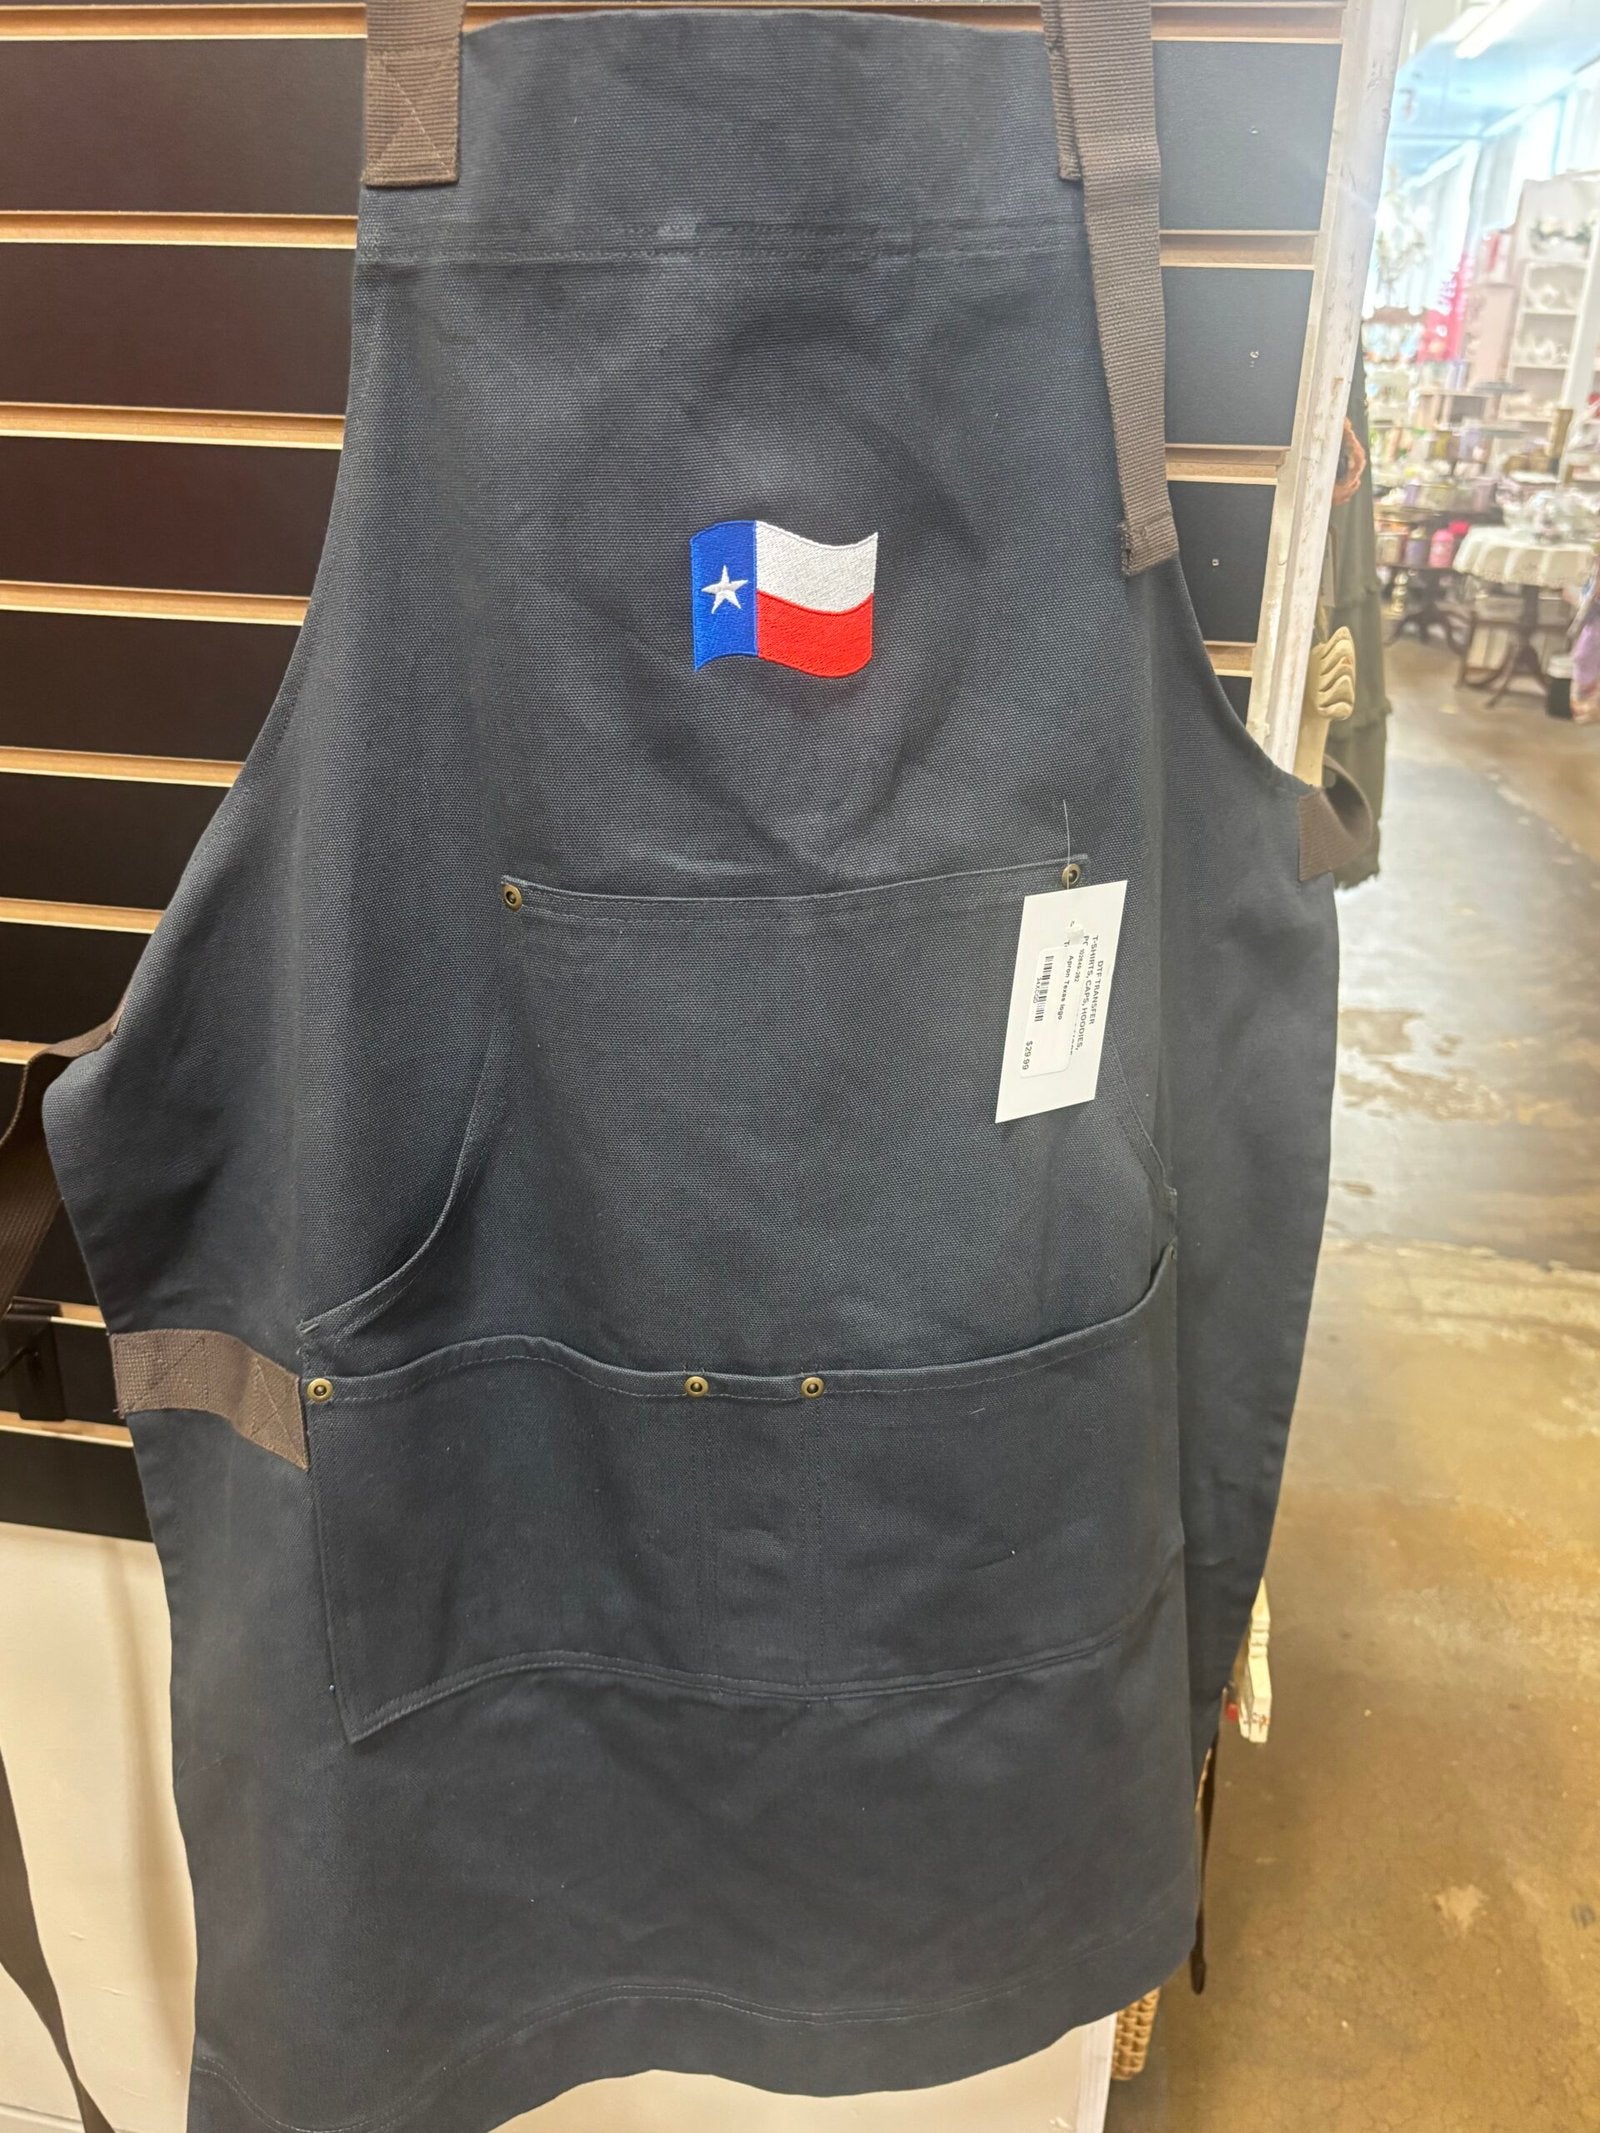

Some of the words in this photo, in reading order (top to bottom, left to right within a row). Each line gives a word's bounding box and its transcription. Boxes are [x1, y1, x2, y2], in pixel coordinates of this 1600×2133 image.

[1064, 955, 1074, 978] Apron
[1085, 935, 1098, 978] T-SHIRTS,
[1095, 960, 1104, 977] DTF
[1060, 979, 1069, 1001] Texas
[1081, 979, 1091, 1006] CAPS,
[1088, 978, 1101, 1024] TRANSFER
[1057, 1003, 1065, 1020] logo
[1074, 1007, 1087, 1050] HOODIES,
[1021, 1040, 1033, 1070] $29.99
